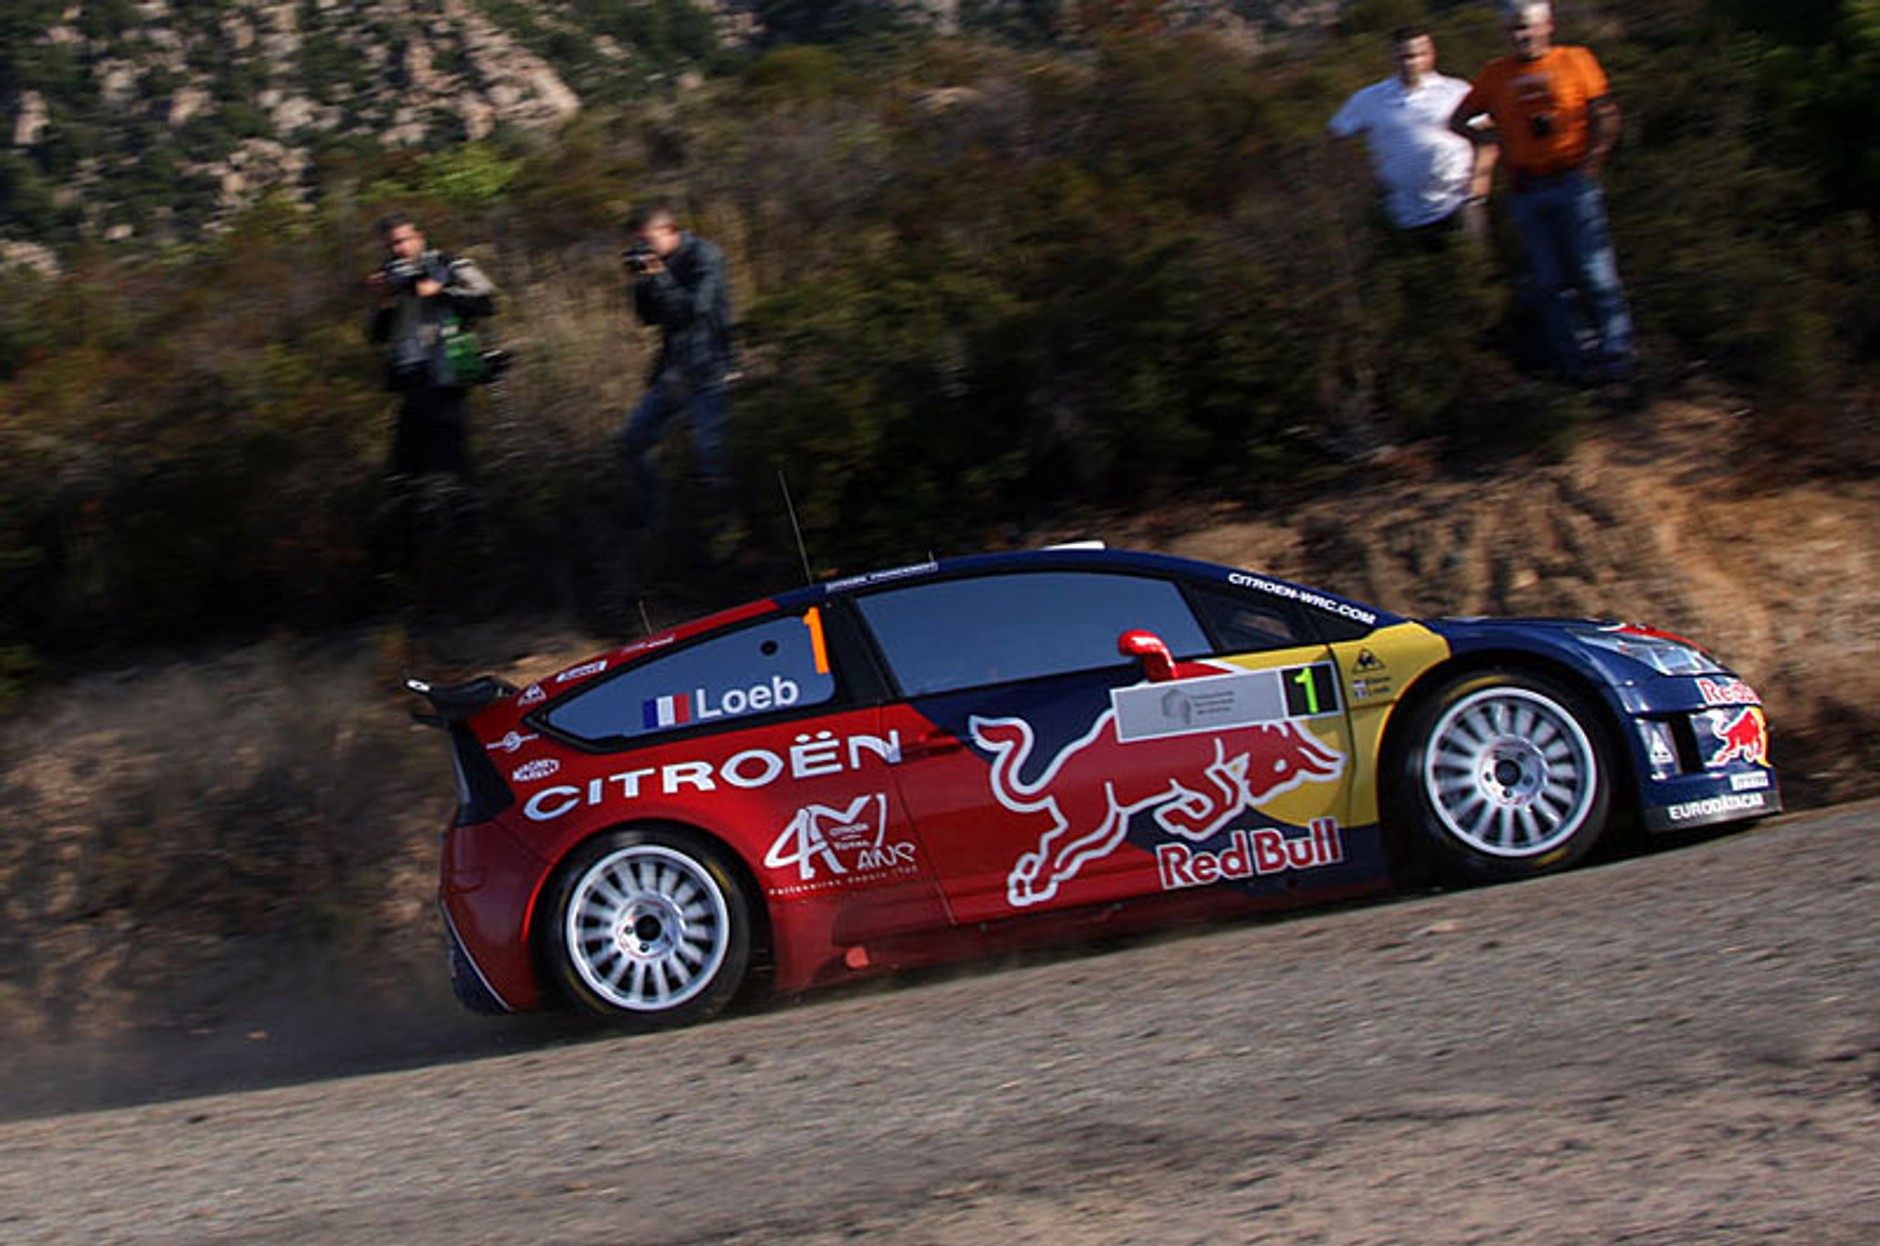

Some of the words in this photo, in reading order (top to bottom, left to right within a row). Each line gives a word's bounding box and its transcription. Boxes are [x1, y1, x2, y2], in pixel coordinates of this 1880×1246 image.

[1228, 573, 1376, 624] CITROEN-WRC.COM
[803, 607, 829, 674] 1
[696, 676, 799, 718] Loeb
[1295, 667, 1318, 714] 1
[523, 730, 901, 821] CITROËN
[1156, 830, 1253, 890] Red
[1251, 816, 1344, 875] Bull
